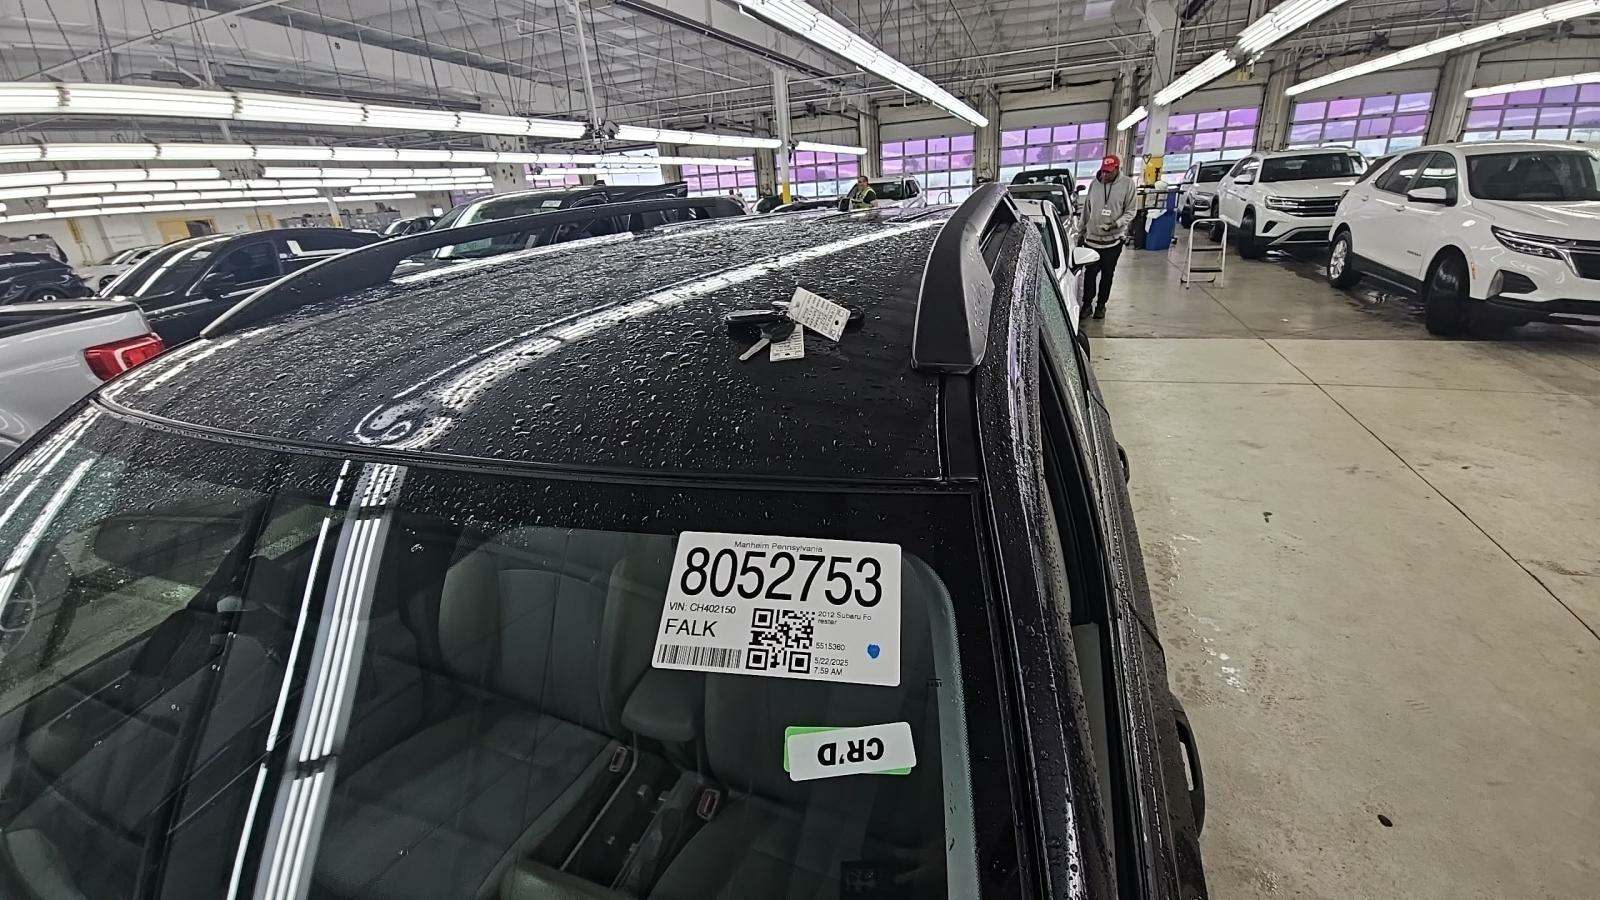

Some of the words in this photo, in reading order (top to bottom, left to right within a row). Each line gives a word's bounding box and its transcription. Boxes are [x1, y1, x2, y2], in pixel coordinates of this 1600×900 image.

[734, 540, 770, 550] Manheim
[771, 542, 824, 553] Pennsylvania
[680, 546, 883, 608] 8052753
[669, 601, 687, 611] VIN:
[689, 602, 737, 615] CH402150
[817, 610, 836, 618] 2012
[836, 611, 862, 621] Subaru
[862, 613, 872, 621] Fo
[664, 618, 719, 638] FALK
[815, 641, 846, 651] 5515360
[814, 656, 849, 667] 5/22/2025
[817, 737, 885, 766] CR'D
